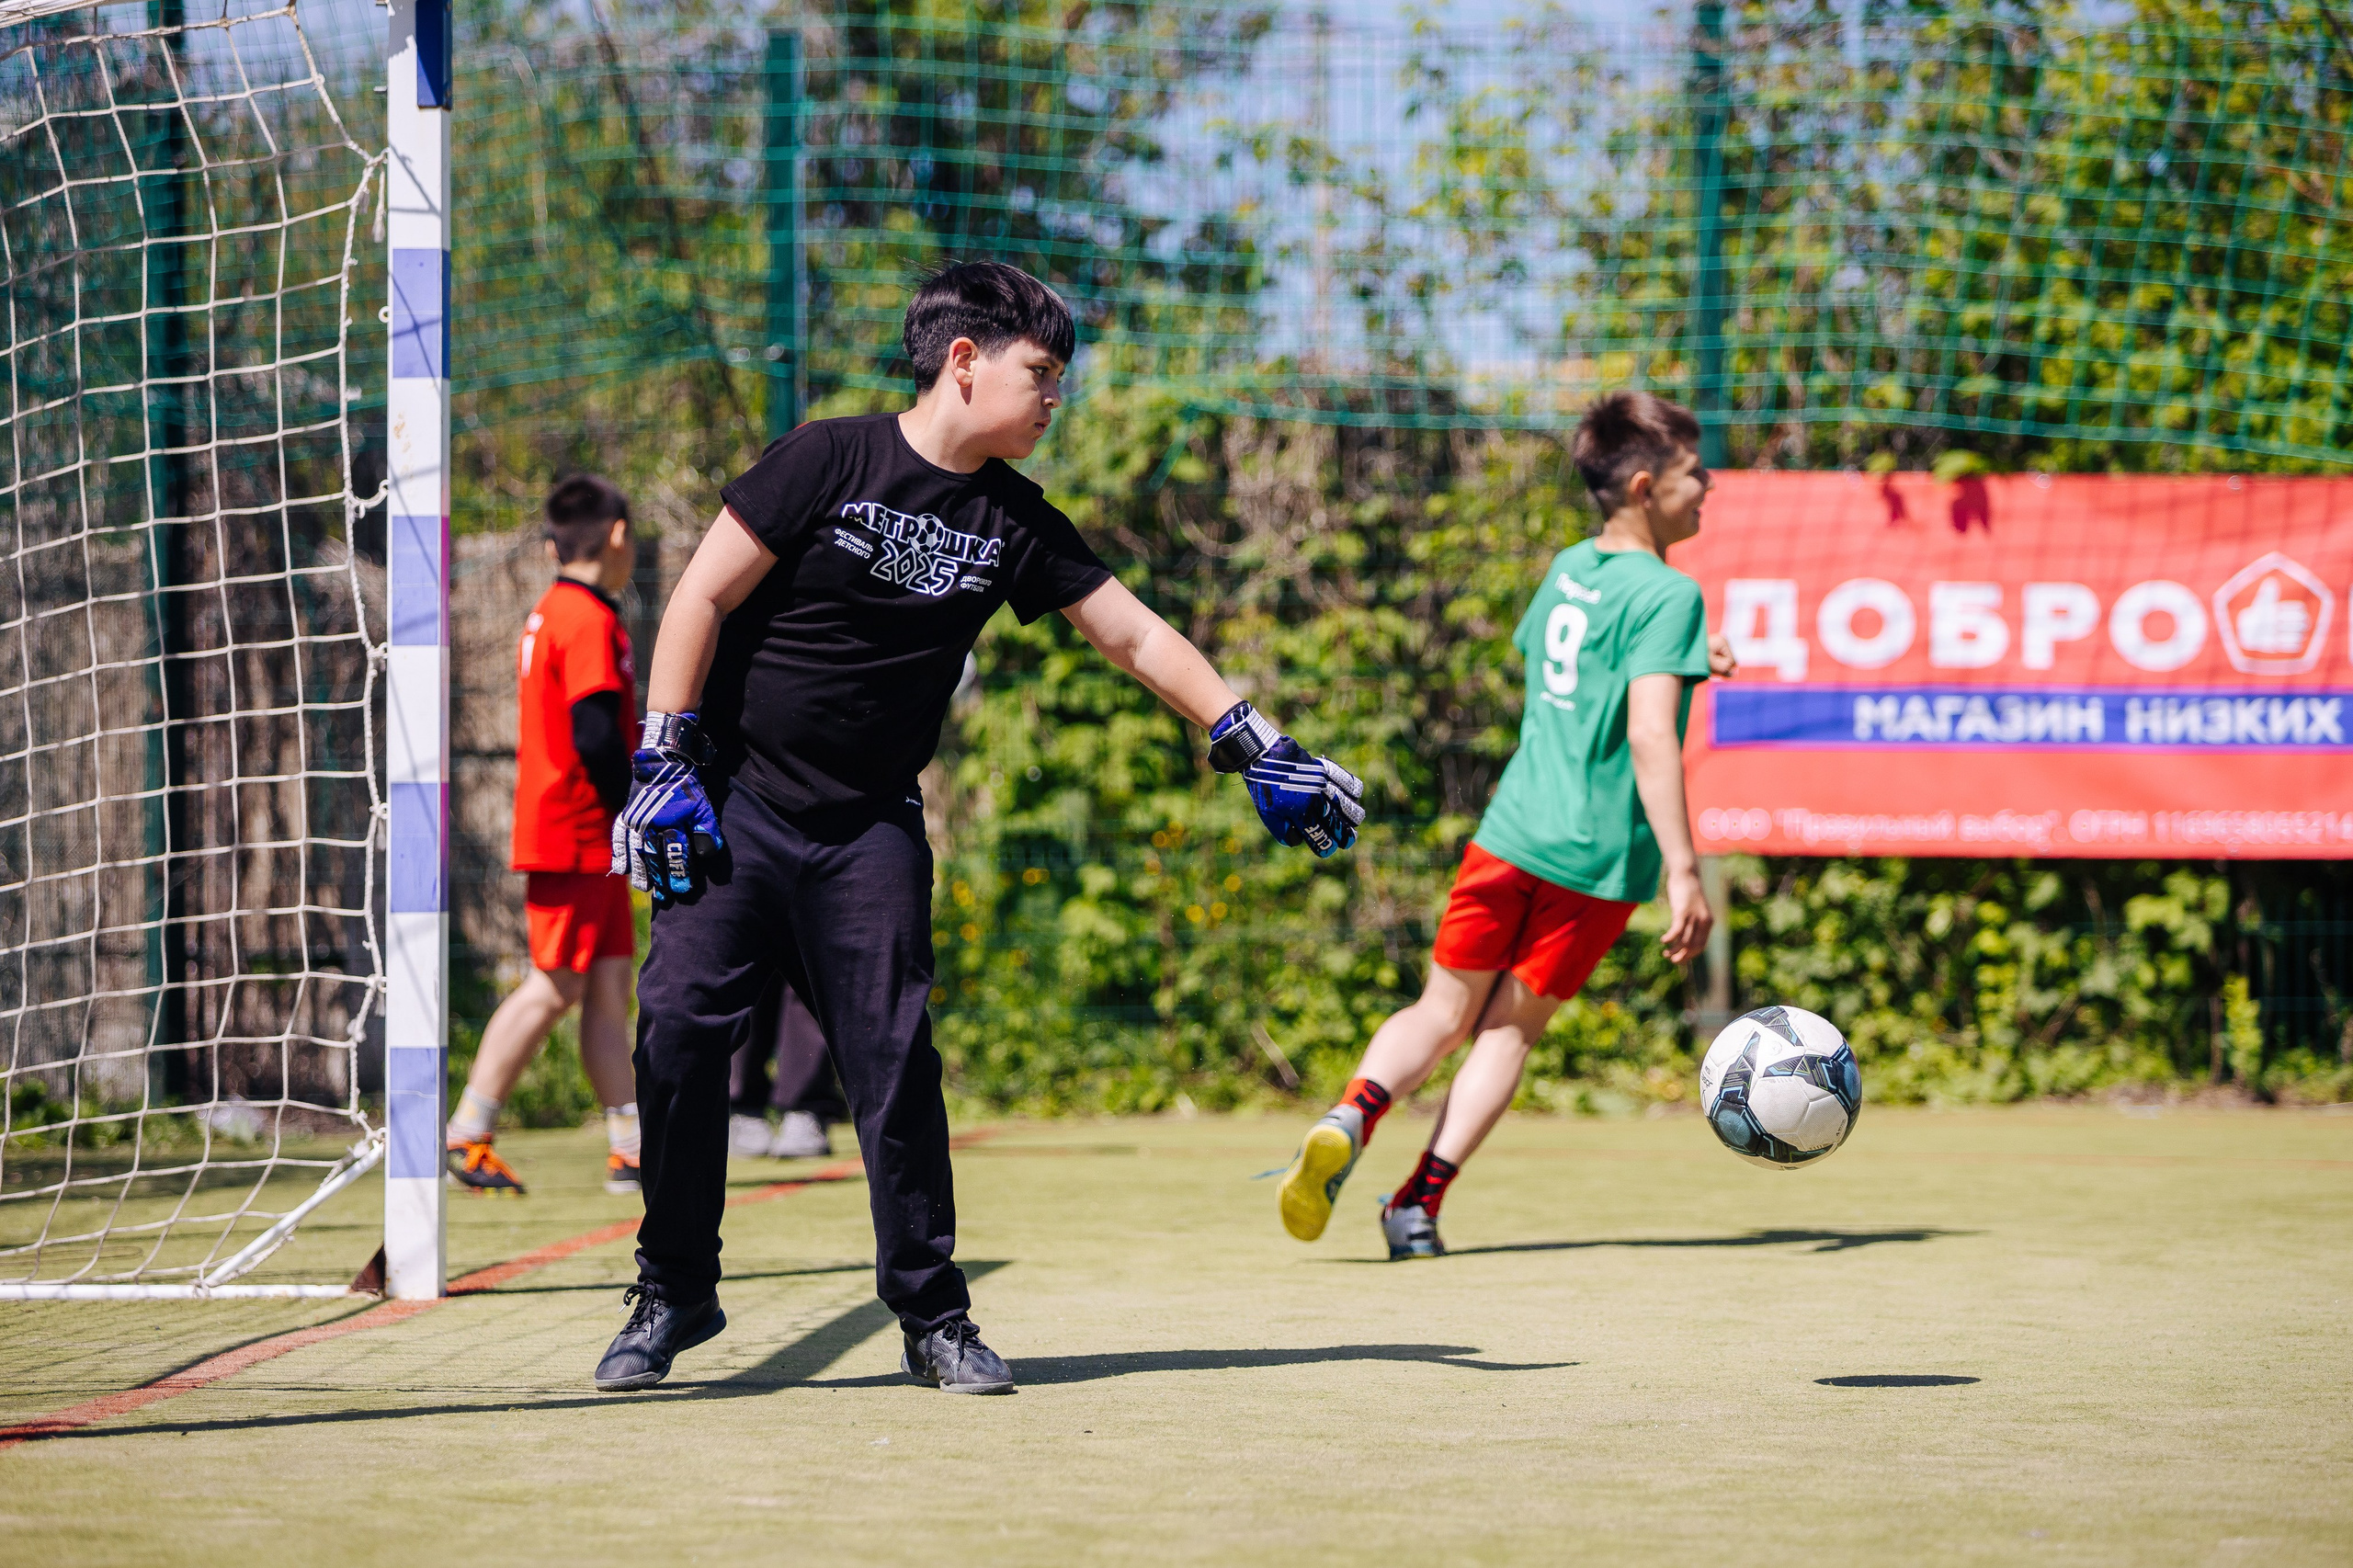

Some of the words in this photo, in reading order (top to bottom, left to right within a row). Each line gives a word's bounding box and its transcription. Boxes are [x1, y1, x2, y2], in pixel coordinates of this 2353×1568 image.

[834, 528, 874, 552] ФЕСТИВАЛЬ
[834, 538, 870, 559] ДЕТСКОГО
[870, 539, 959, 596] 2025
[1542, 603, 1588, 696] 9
[1853, 695, 2106, 744] МАГАЗИН
[2124, 696, 2345, 745] НИЗКИХ
[1304, 824, 1333, 850] CLIFF
[667, 843, 686, 877] CLIFF
